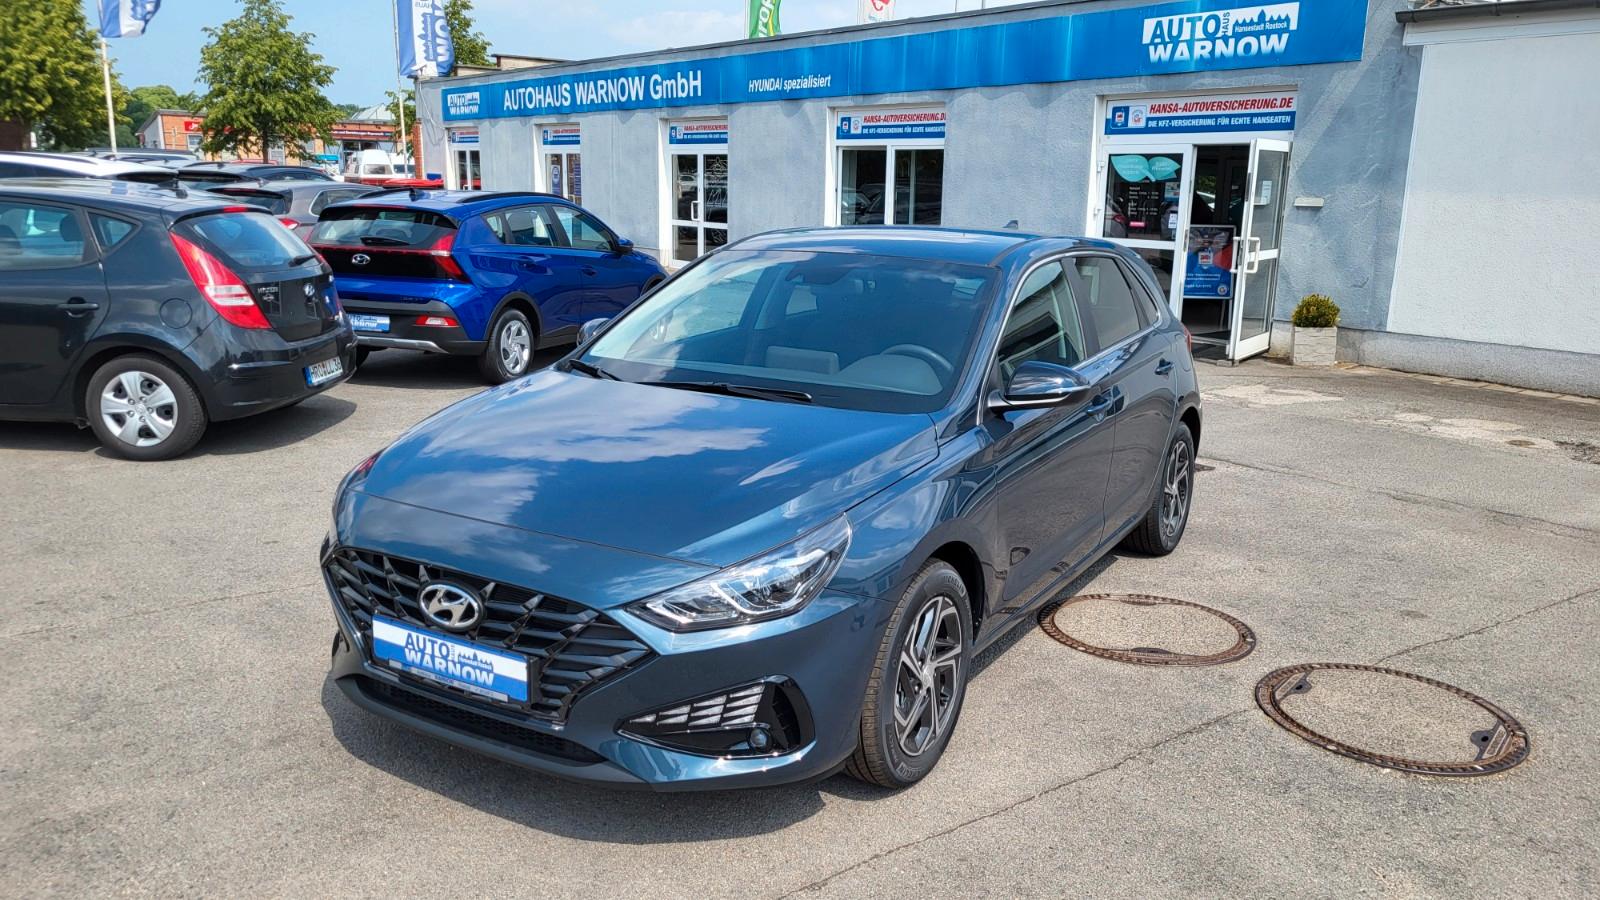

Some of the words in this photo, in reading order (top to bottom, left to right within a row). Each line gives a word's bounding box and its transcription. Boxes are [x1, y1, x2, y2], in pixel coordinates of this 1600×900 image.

[1150, 14, 1221, 43] AUTO
[1222, 12, 1230, 36] HAUS
[1235, 22, 1265, 33] Hansestadt
[1265, 20, 1287, 30] Rostock
[1149, 33, 1289, 63] WARNOW
[504, 83, 571, 111] AUTOHAUS
[574, 76, 645, 105] WARNOW
[649, 70, 702, 100] GmbH
[748, 78, 783, 93] HYUNDAI
[783, 73, 832, 93] spezialisiert
[450, 94, 466, 106] AUTO
[450, 105, 479, 115] WARNOW
[1149, 97, 1294, 114] HANSA-AUTOVERSICHERUNG.DE
[1148, 120, 1158, 128] DIE
[1158, 117, 1216, 128] KFZ-VERSICHERUNG
[1217, 117, 1229, 126] FÜR
[1231, 116, 1251, 125] ECHTE
[1252, 115, 1291, 124] HANSEATEN
[405, 633, 450, 658] AUTO
[405, 648, 494, 687] WARNOW
